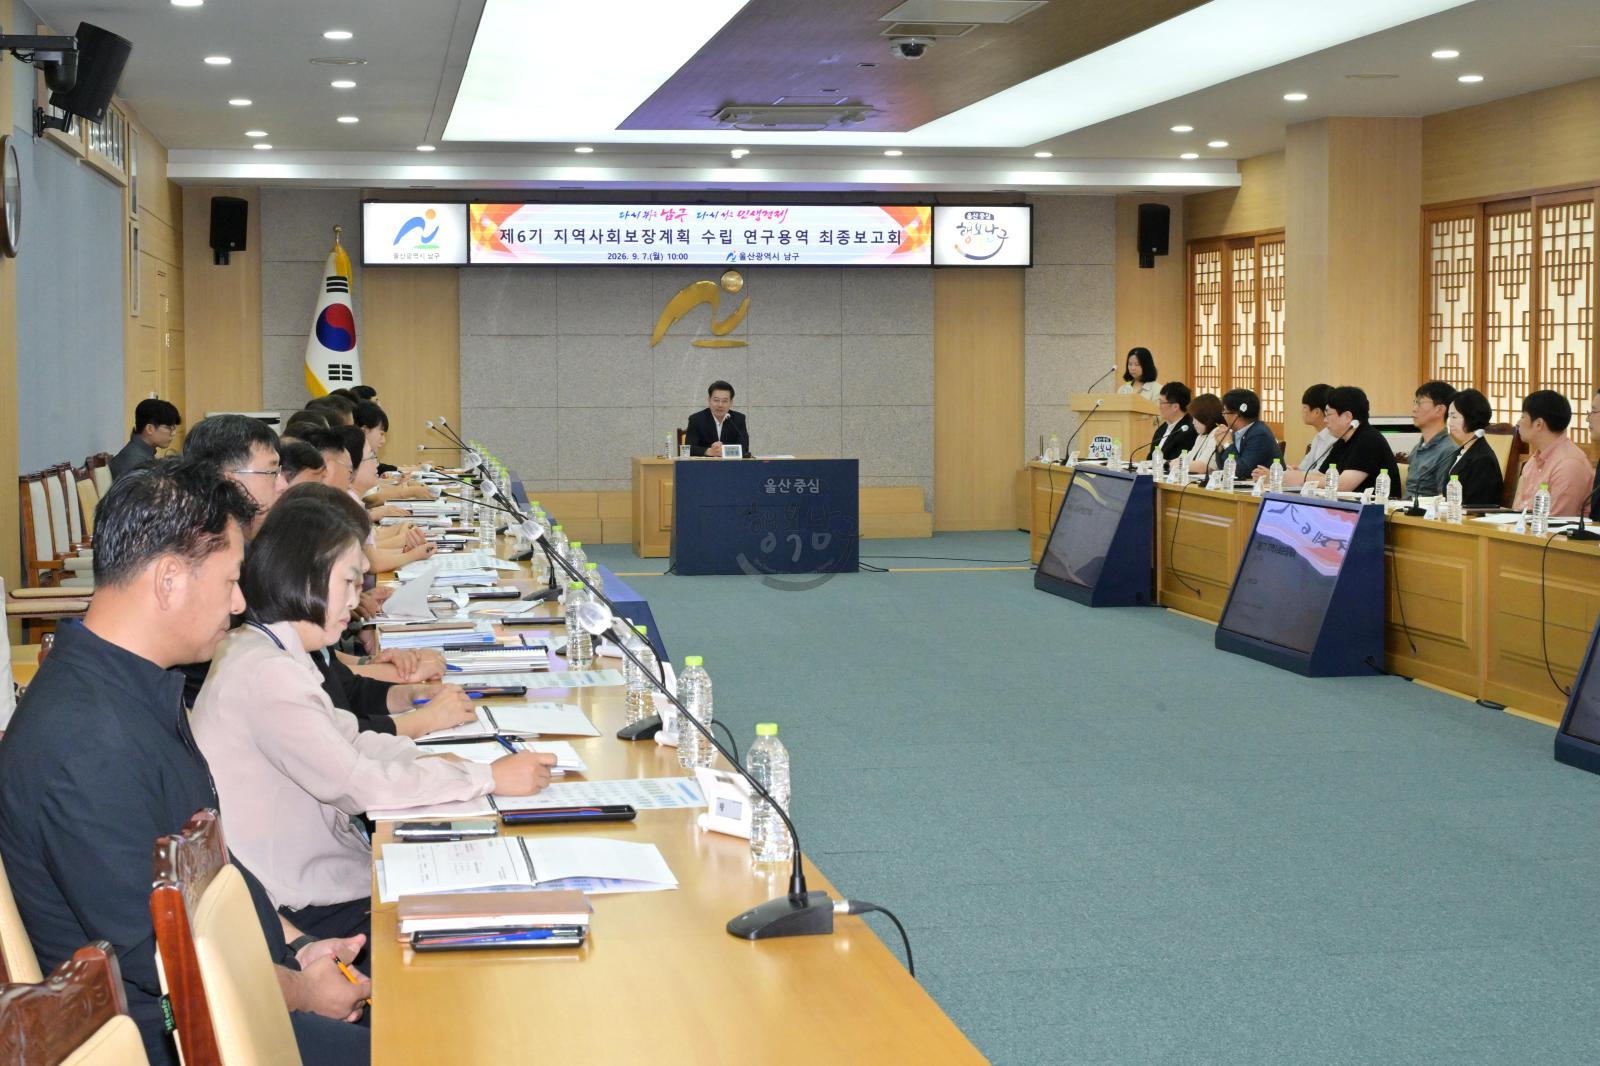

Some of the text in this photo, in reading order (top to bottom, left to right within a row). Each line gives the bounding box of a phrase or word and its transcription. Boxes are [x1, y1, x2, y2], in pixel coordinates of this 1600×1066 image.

[660, 208, 689, 223] 남구
[499, 229, 901, 245] 제6기 지역사회보장계획 수립 연구용역 최종보고회
[607, 252, 629, 261] 2026.
[667, 252, 689, 261] 10:00
[739, 252, 800, 262] 울산광역시 남구
